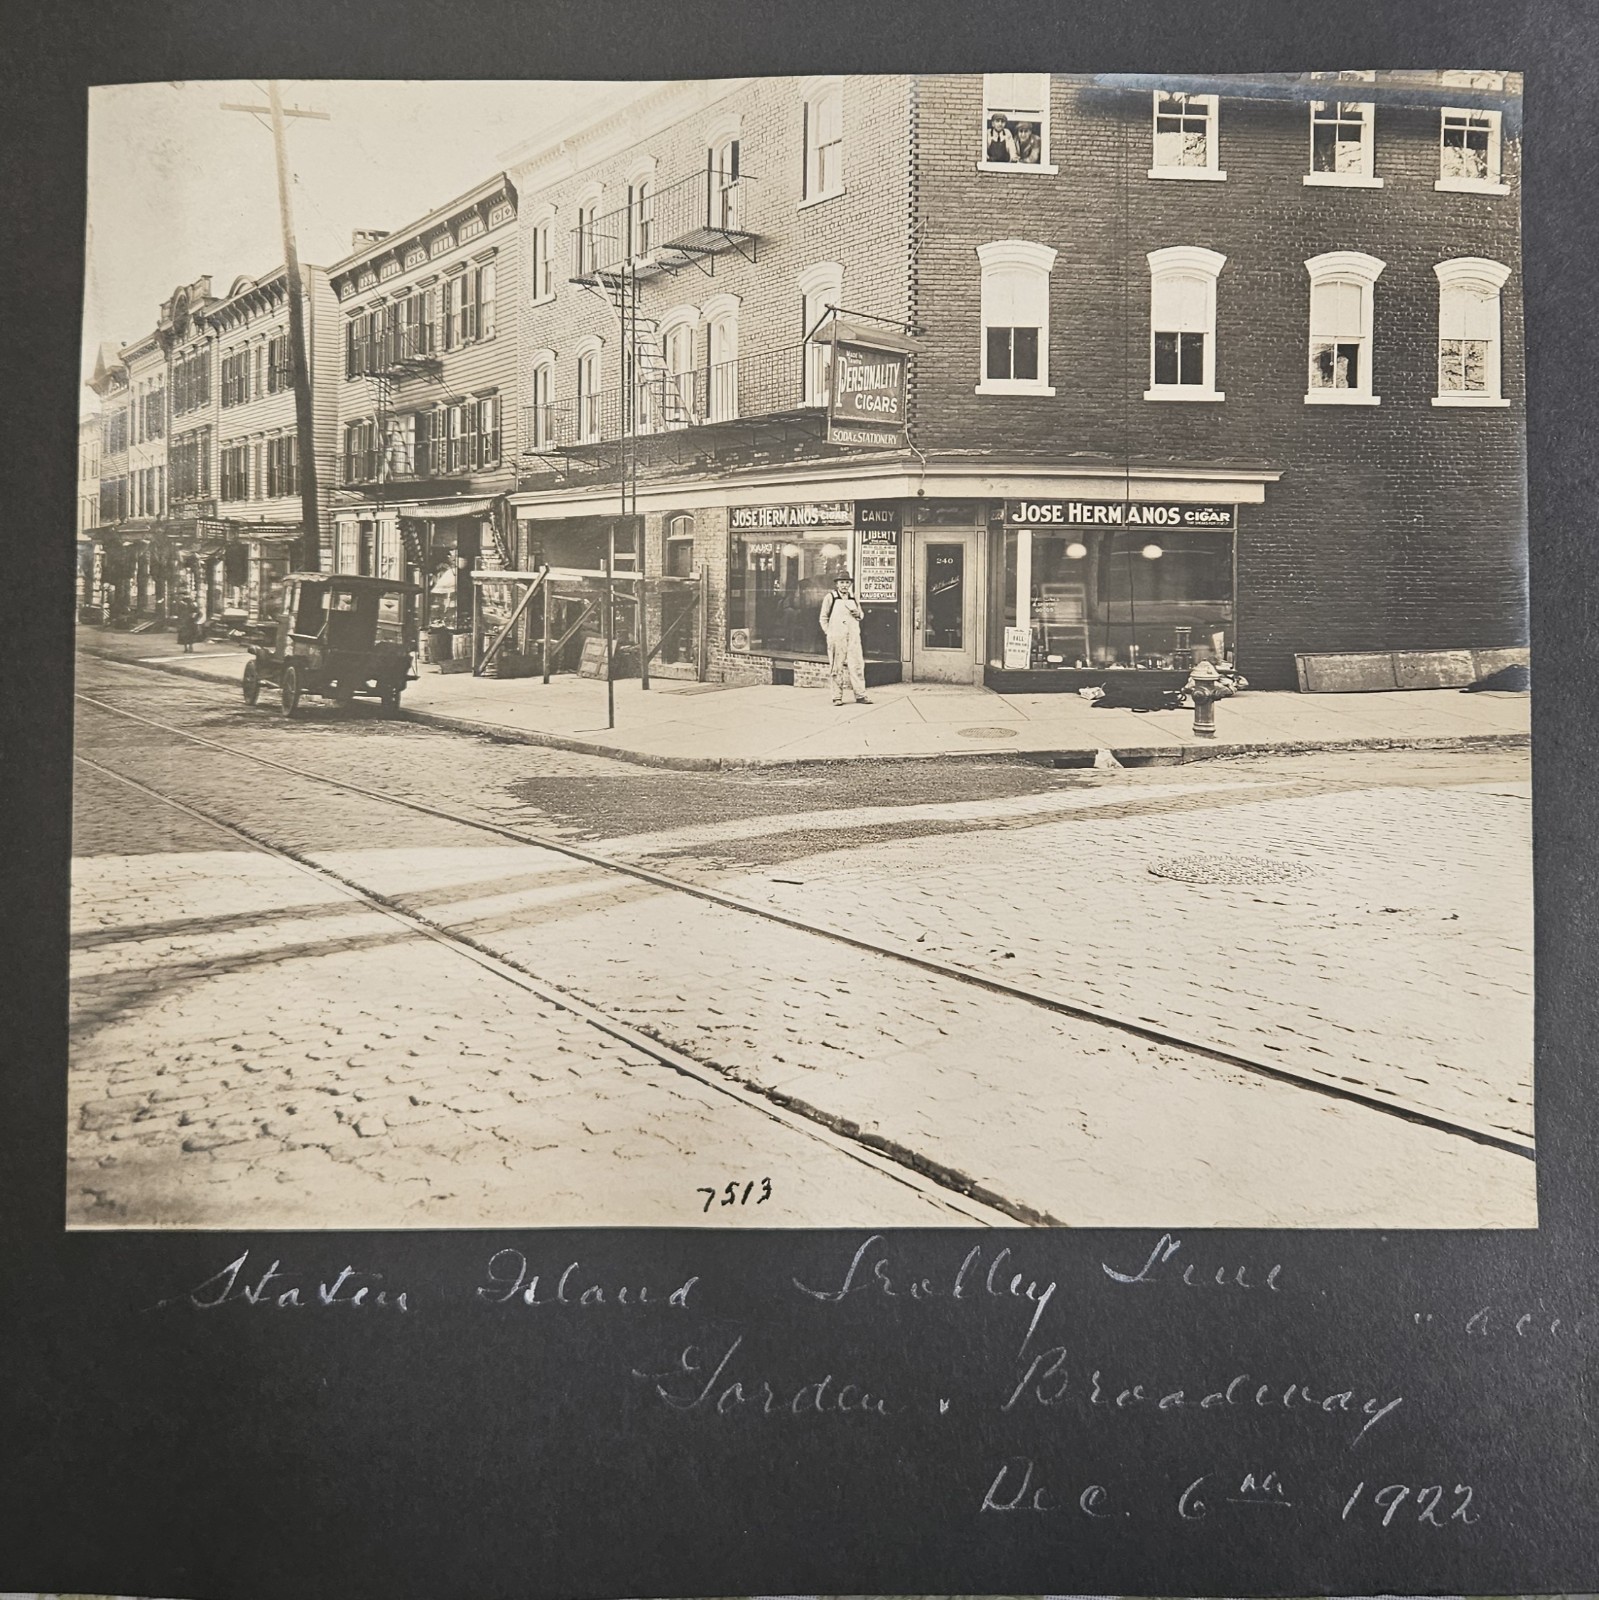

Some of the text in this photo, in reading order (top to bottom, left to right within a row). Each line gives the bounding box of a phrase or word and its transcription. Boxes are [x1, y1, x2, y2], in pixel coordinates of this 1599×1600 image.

[836, 356, 900, 407] PERSONALITY
[855, 393, 898, 413] CIGARS
[732, 509, 757, 526] JOSE
[759, 507, 818, 526] HERMANOS
[820, 511, 848, 520] CIGAR
[862, 509, 895, 522] CANDY
[1012, 502, 1230, 525] JOSE HERMANOS CIGAR
[862, 531, 897, 542] LIBERTY
[696, 1176, 772, 1212] 7513
[190, 1249, 408, 1310] Staten
[478, 1248, 699, 1307] Island
[1001, 1346, 1403, 1452] Broadway
[1342, 1480, 1480, 1528] 1922
